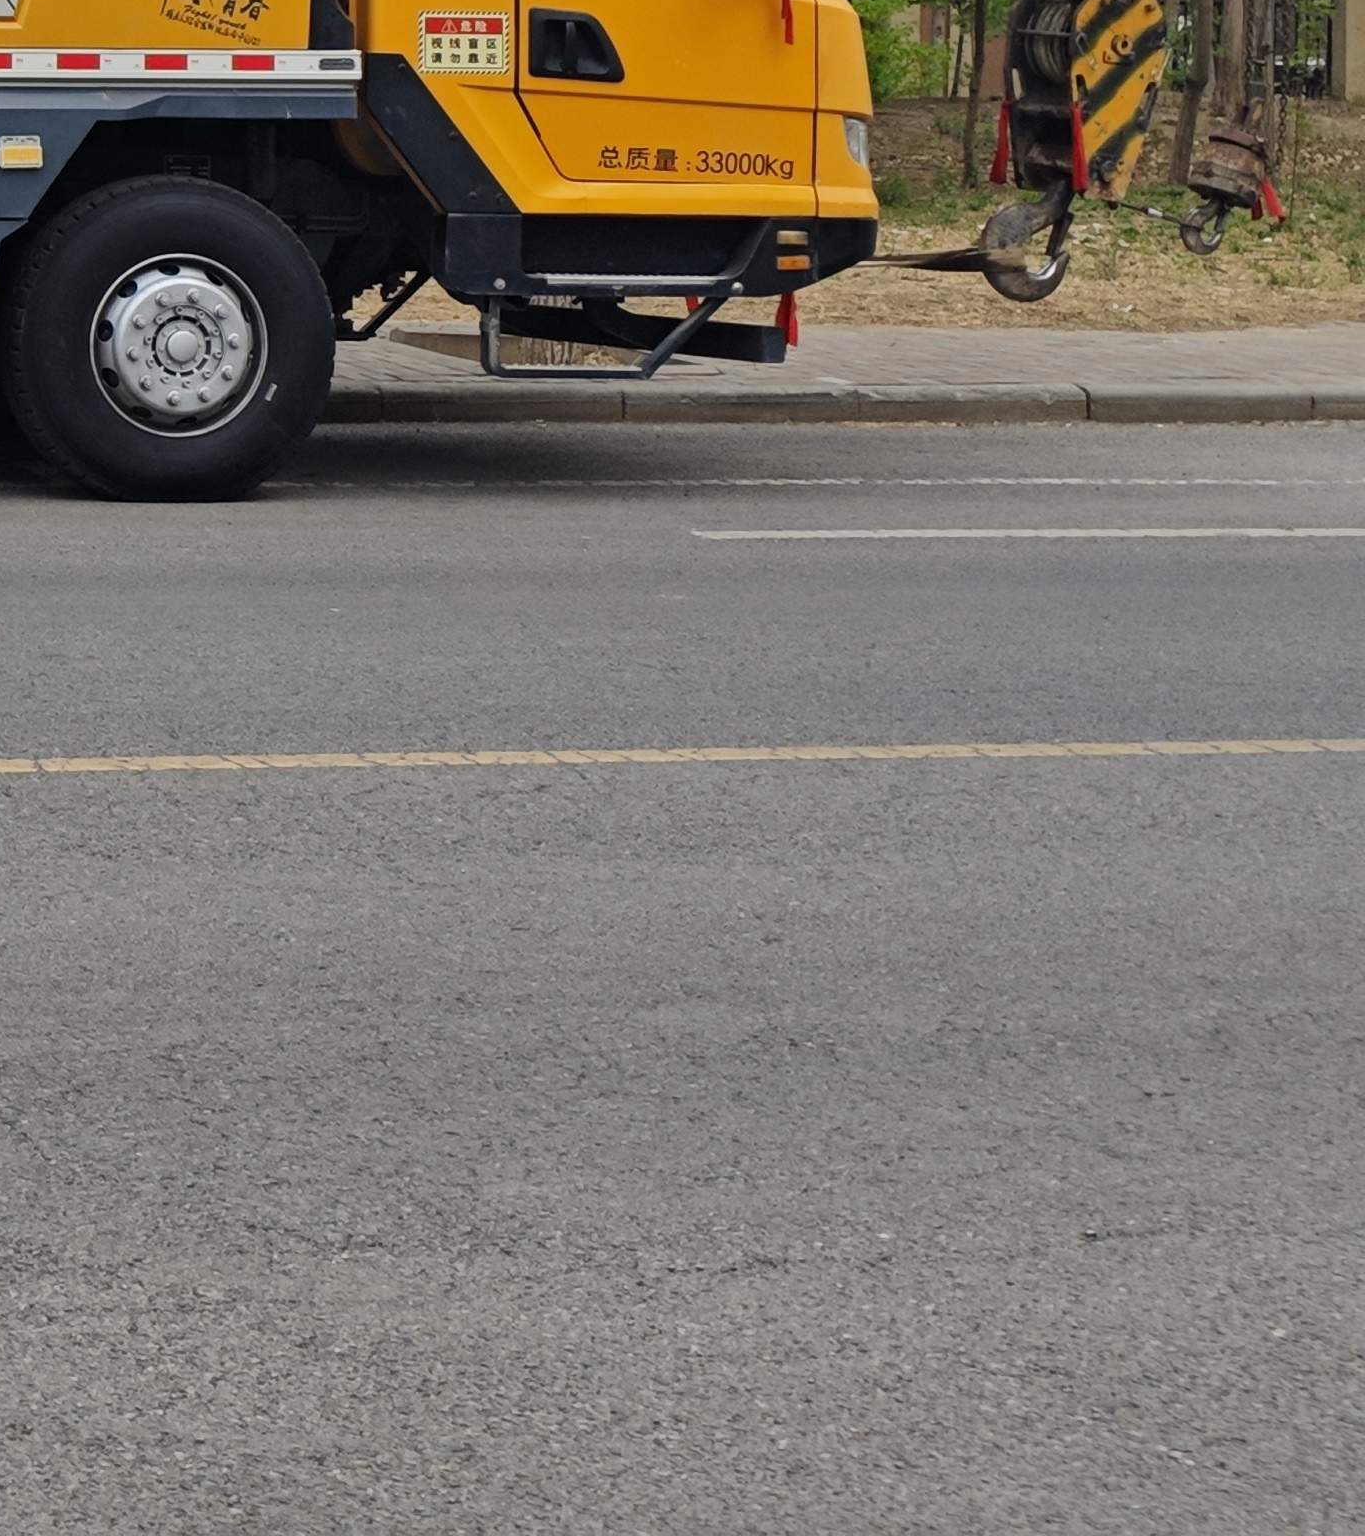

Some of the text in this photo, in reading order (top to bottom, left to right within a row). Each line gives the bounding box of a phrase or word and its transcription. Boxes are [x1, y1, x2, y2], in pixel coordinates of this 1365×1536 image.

[460, 20, 488, 33] 危险
[431, 37, 498, 50] 视线盲区
[431, 52, 498, 65] 请勿靠近
